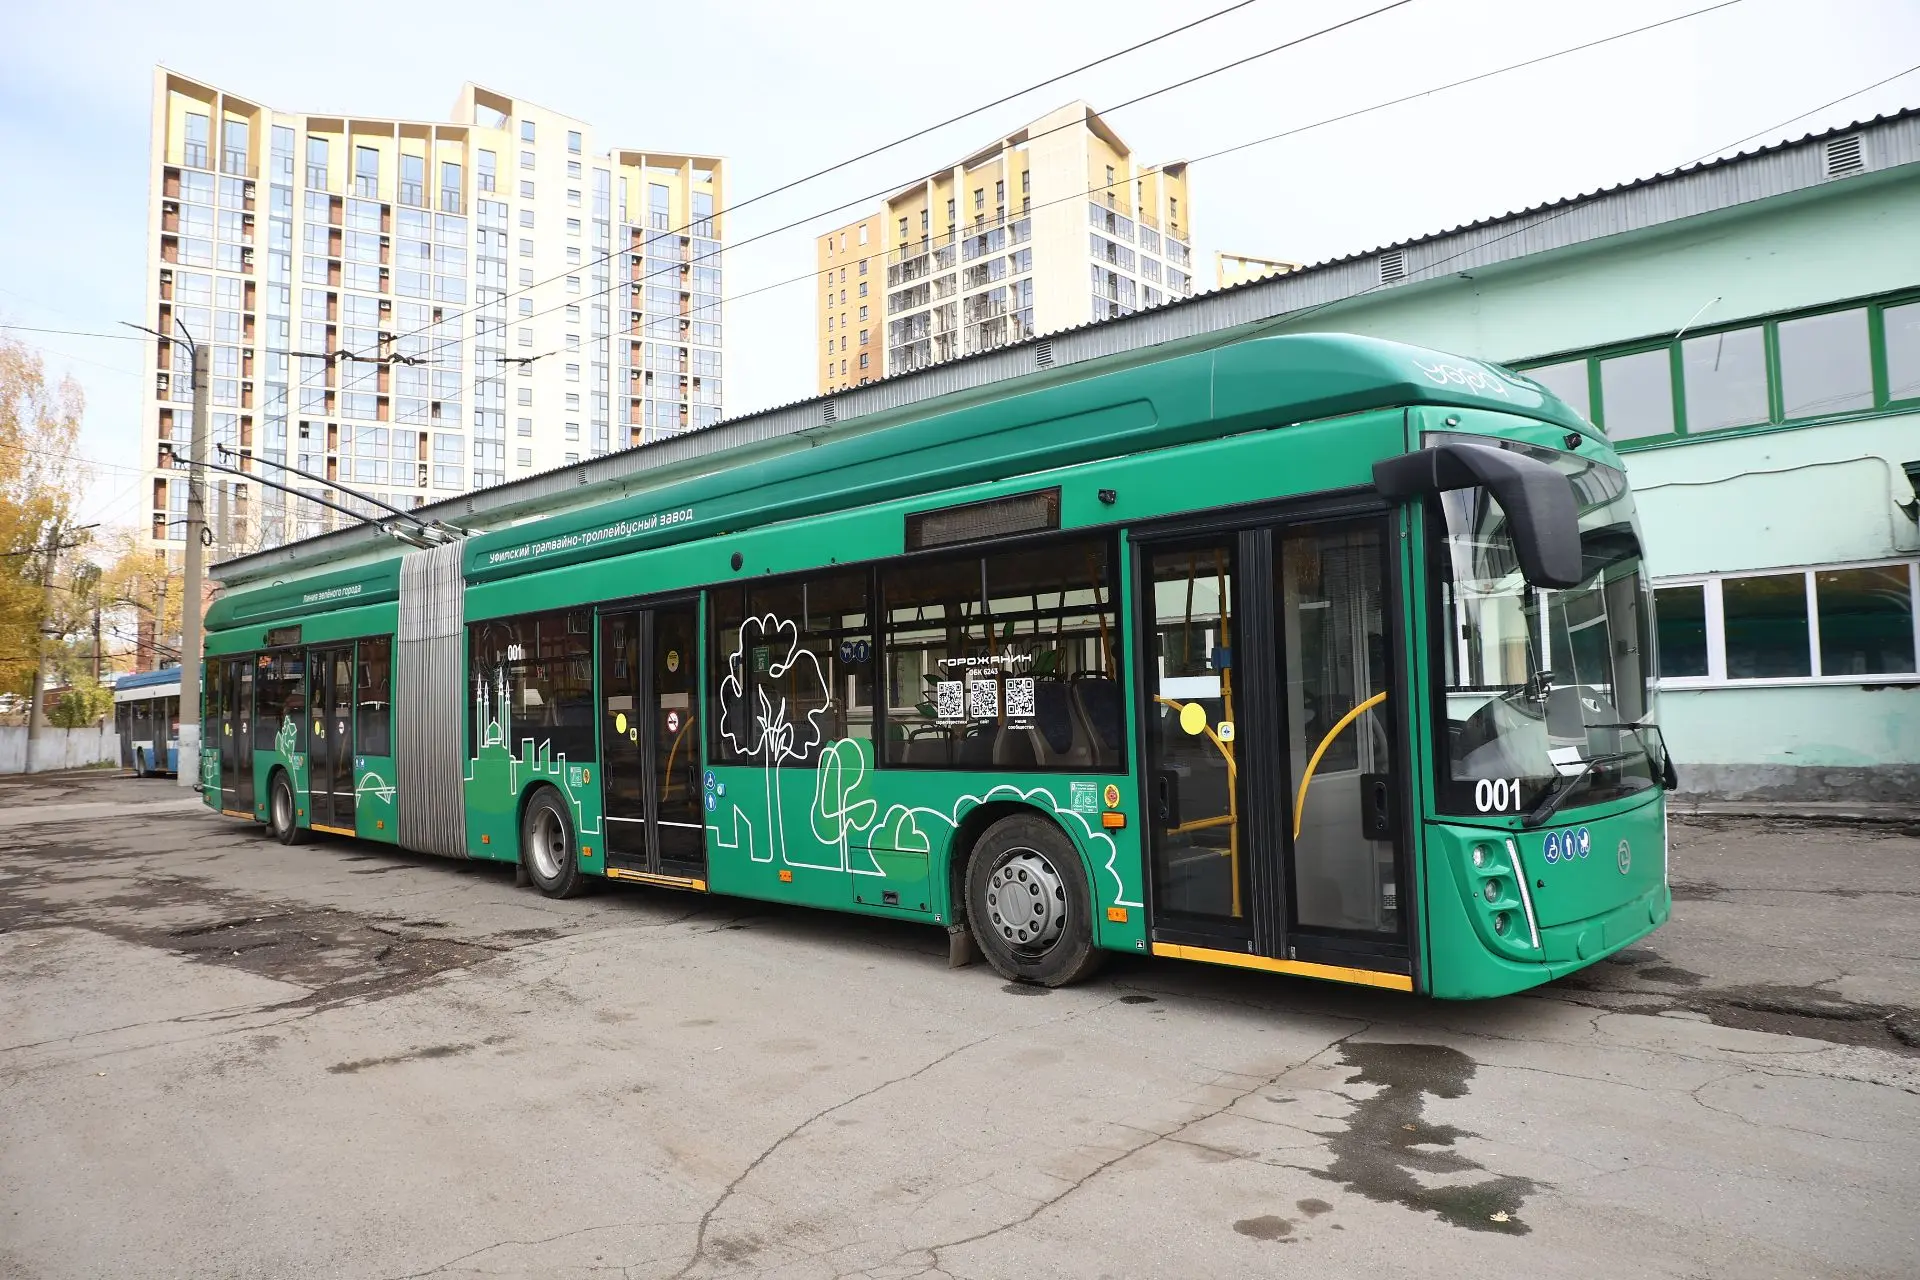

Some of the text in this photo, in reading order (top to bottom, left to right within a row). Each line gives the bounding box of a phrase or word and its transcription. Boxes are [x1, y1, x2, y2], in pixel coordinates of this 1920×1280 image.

[489, 508, 693, 564] Уфимский трамвайно-троллейбусный завод
[342, 584, 362, 597] города
[507, 643, 522, 661] 001
[937, 653, 1032, 667] ГОРОЖАНИН
[983, 667, 999, 676] 6243
[1475, 777, 1521, 813] 001
